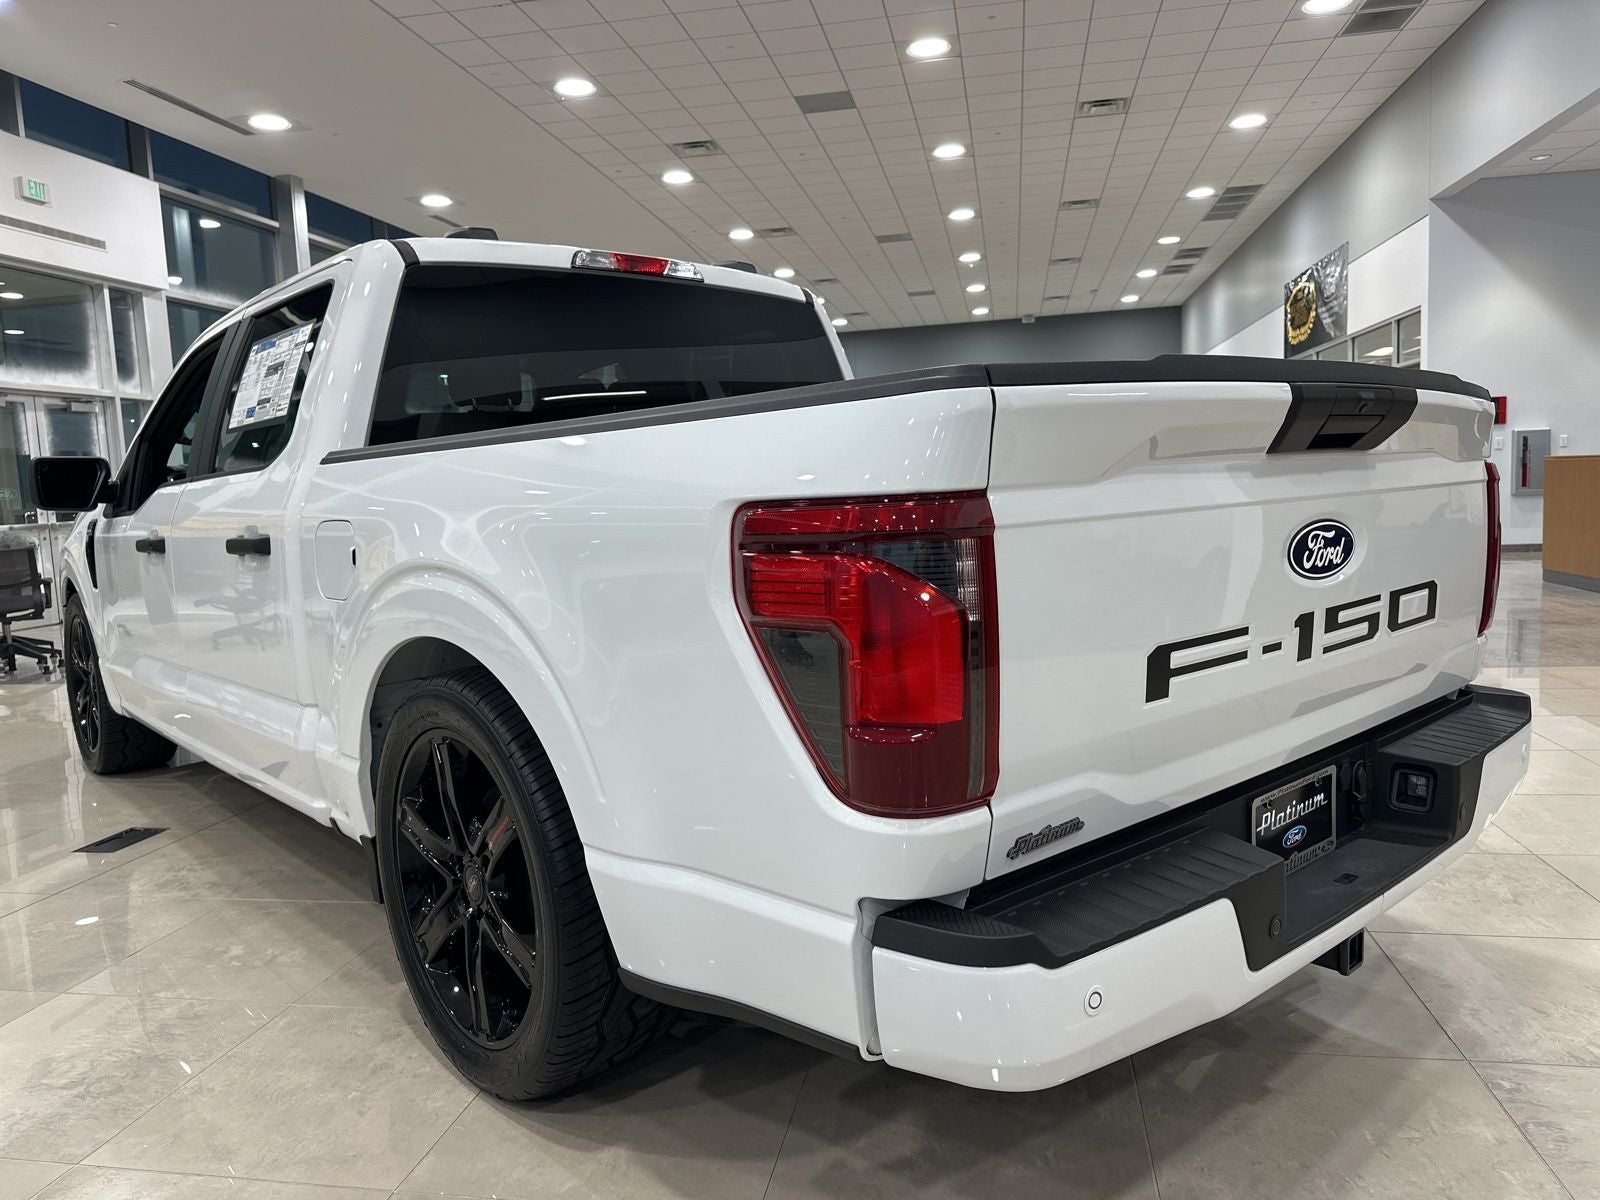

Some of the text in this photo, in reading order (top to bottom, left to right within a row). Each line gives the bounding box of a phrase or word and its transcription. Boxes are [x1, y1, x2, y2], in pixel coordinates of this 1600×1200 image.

[27, 179, 46, 200] EXIT
[1303, 530, 1345, 569] Ford
[1145, 579, 1438, 704] F-150
[1257, 793, 1328, 836] Platinum
[1006, 817, 1085, 860] Platinum
